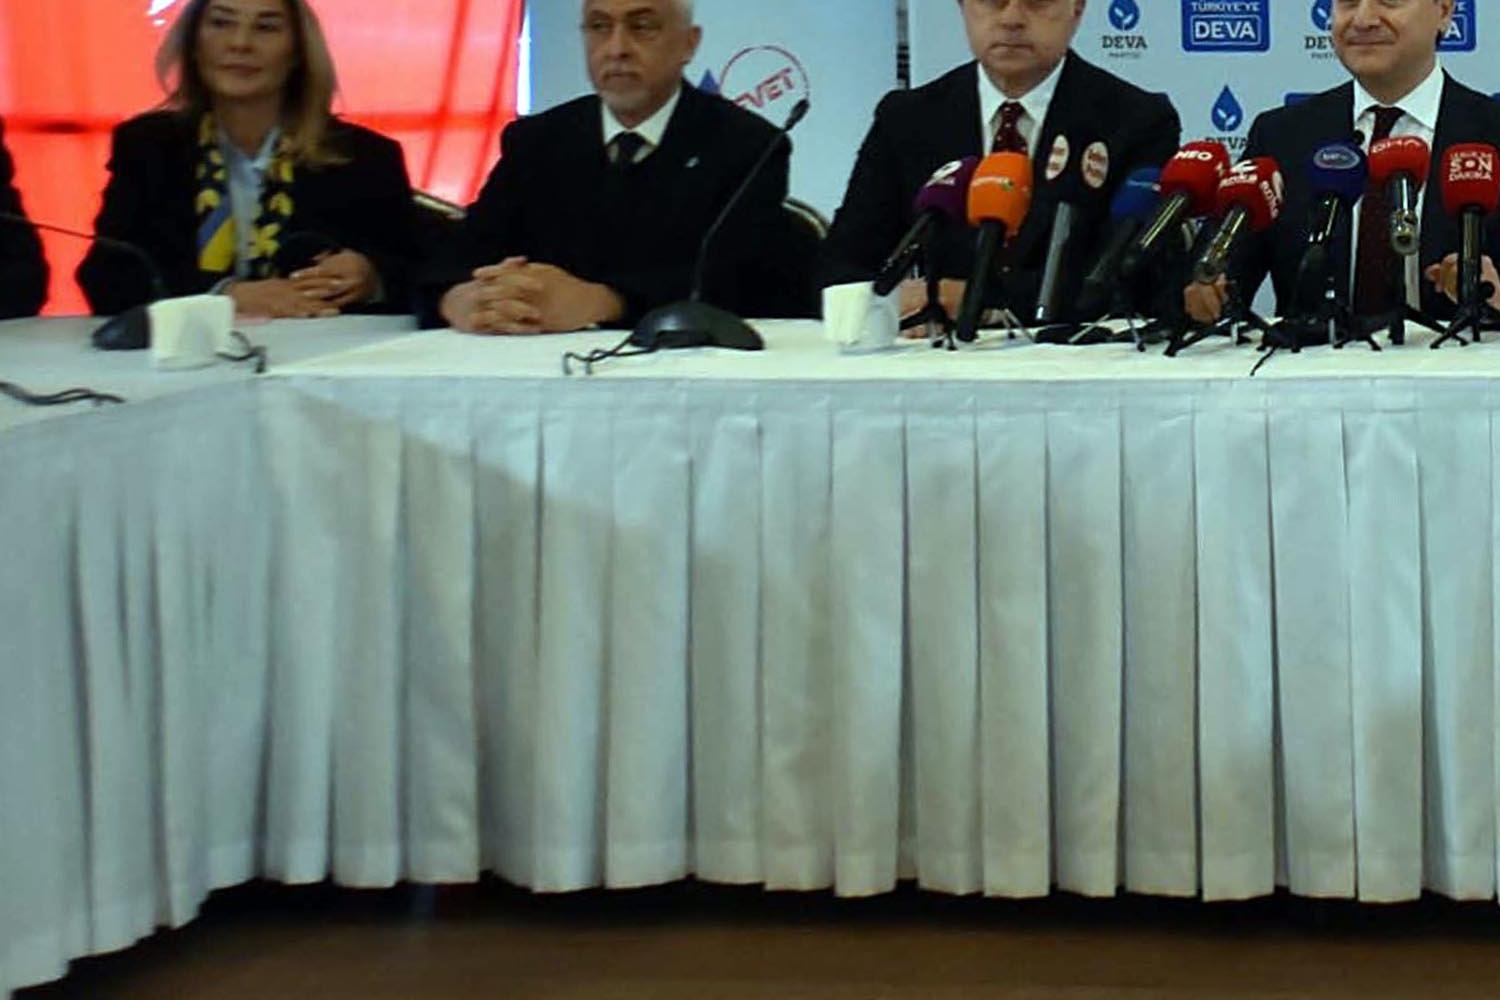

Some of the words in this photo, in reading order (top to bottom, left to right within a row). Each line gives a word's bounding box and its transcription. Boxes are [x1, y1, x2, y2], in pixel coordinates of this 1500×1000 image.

[1195, 21, 1256, 39] DEVA
[1102, 36, 1148, 49] DEVA
[735, 67, 795, 108] VET
